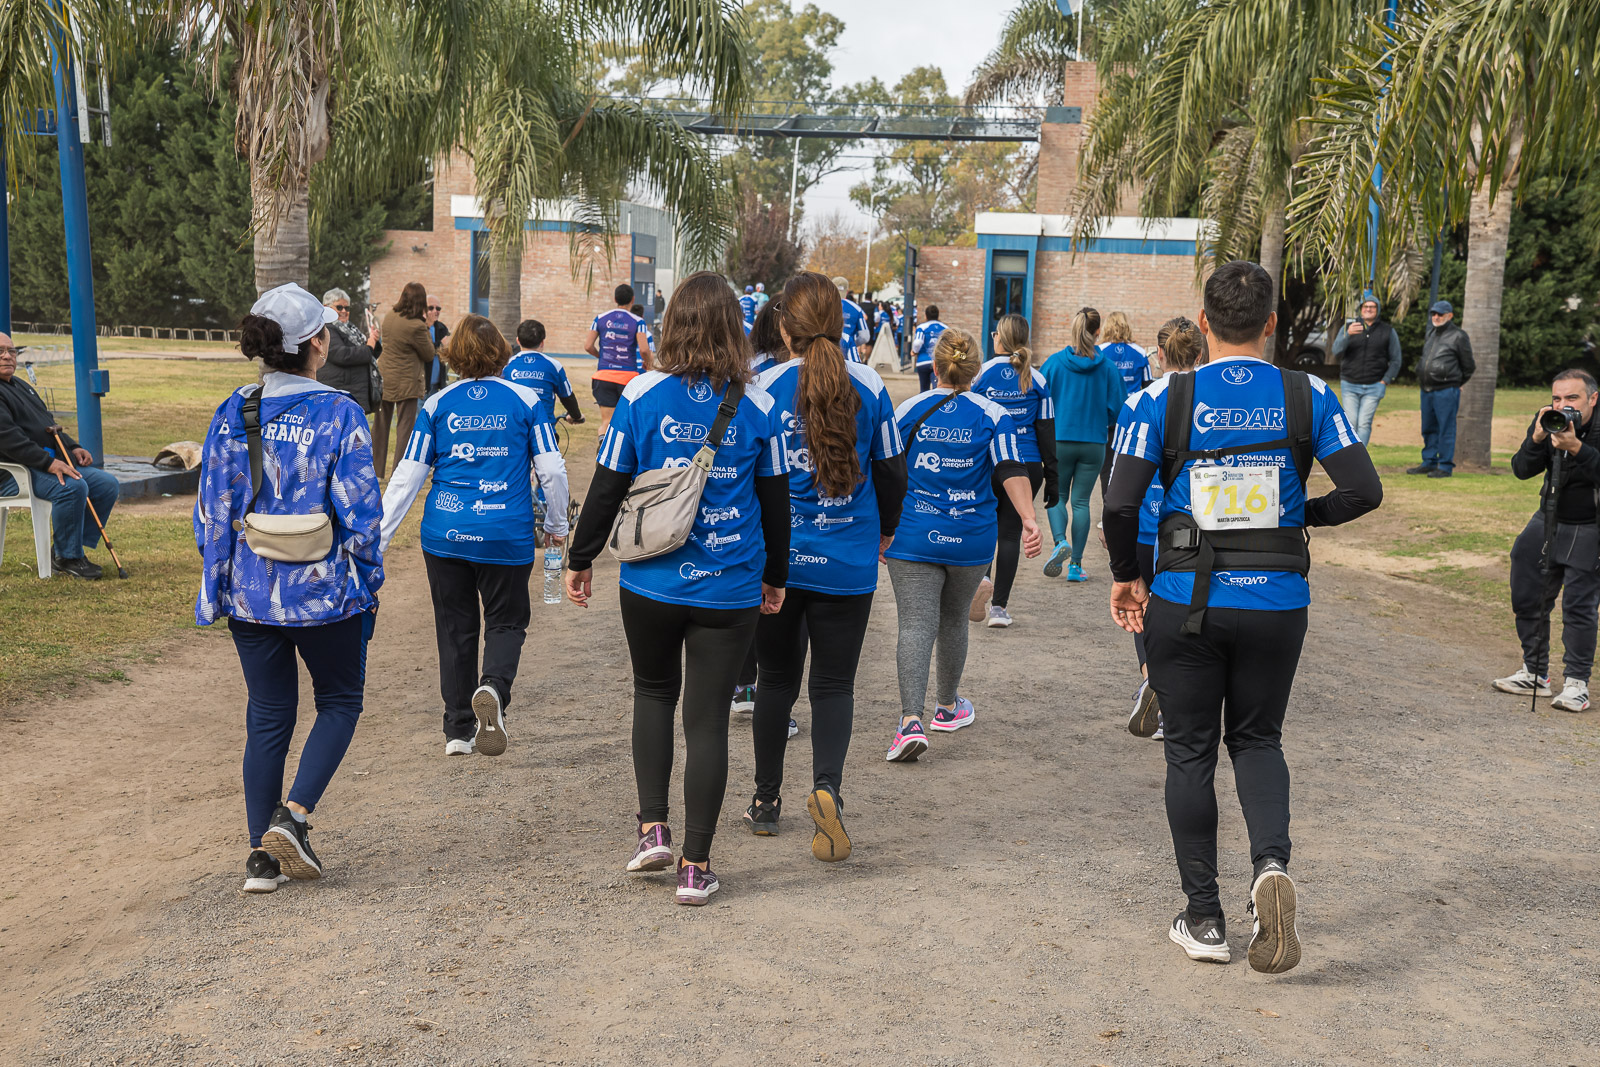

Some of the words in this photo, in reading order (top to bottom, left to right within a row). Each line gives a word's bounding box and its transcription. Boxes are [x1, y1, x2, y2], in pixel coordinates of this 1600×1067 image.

[447, 412, 507, 434] CEDAR
[1194, 402, 1284, 433] CEDAR
[660, 414, 737, 443] CEDR
[916, 423, 973, 443] CEDAR
[448, 442, 475, 462] AQ
[914, 452, 941, 473] AQ
[1236, 454, 1273, 462] COMUNA
[1200, 484, 1268, 515] 716
